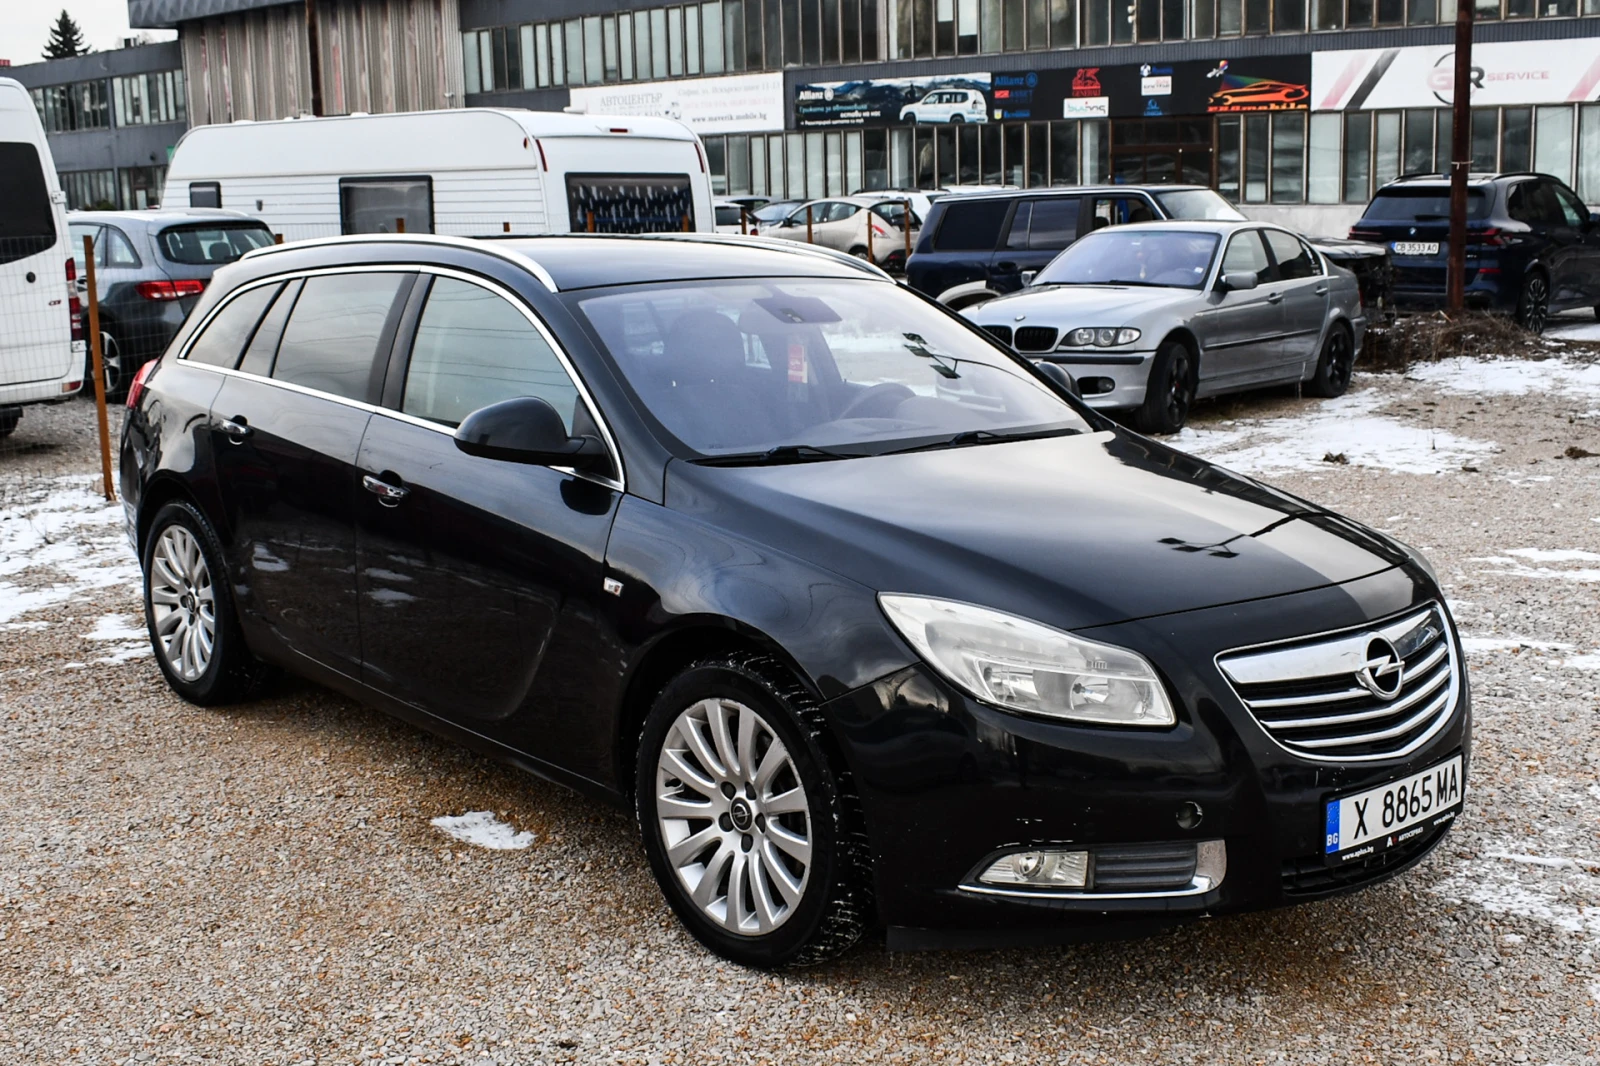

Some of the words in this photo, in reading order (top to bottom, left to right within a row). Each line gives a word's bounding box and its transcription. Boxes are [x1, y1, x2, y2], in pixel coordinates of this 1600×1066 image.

[1487, 71, 1550, 82] SERVICE
[600, 93, 662, 106] АВТОЦЕНТЪР
[800, 90, 824, 100] Allianz
[1354, 798, 1369, 840] X
[1382, 774, 1432, 828] 8865
[1436, 763, 1458, 807] MA
[1326, 832, 1339, 847] BG
[1342, 845, 1375, 861] www.aplus.bg
